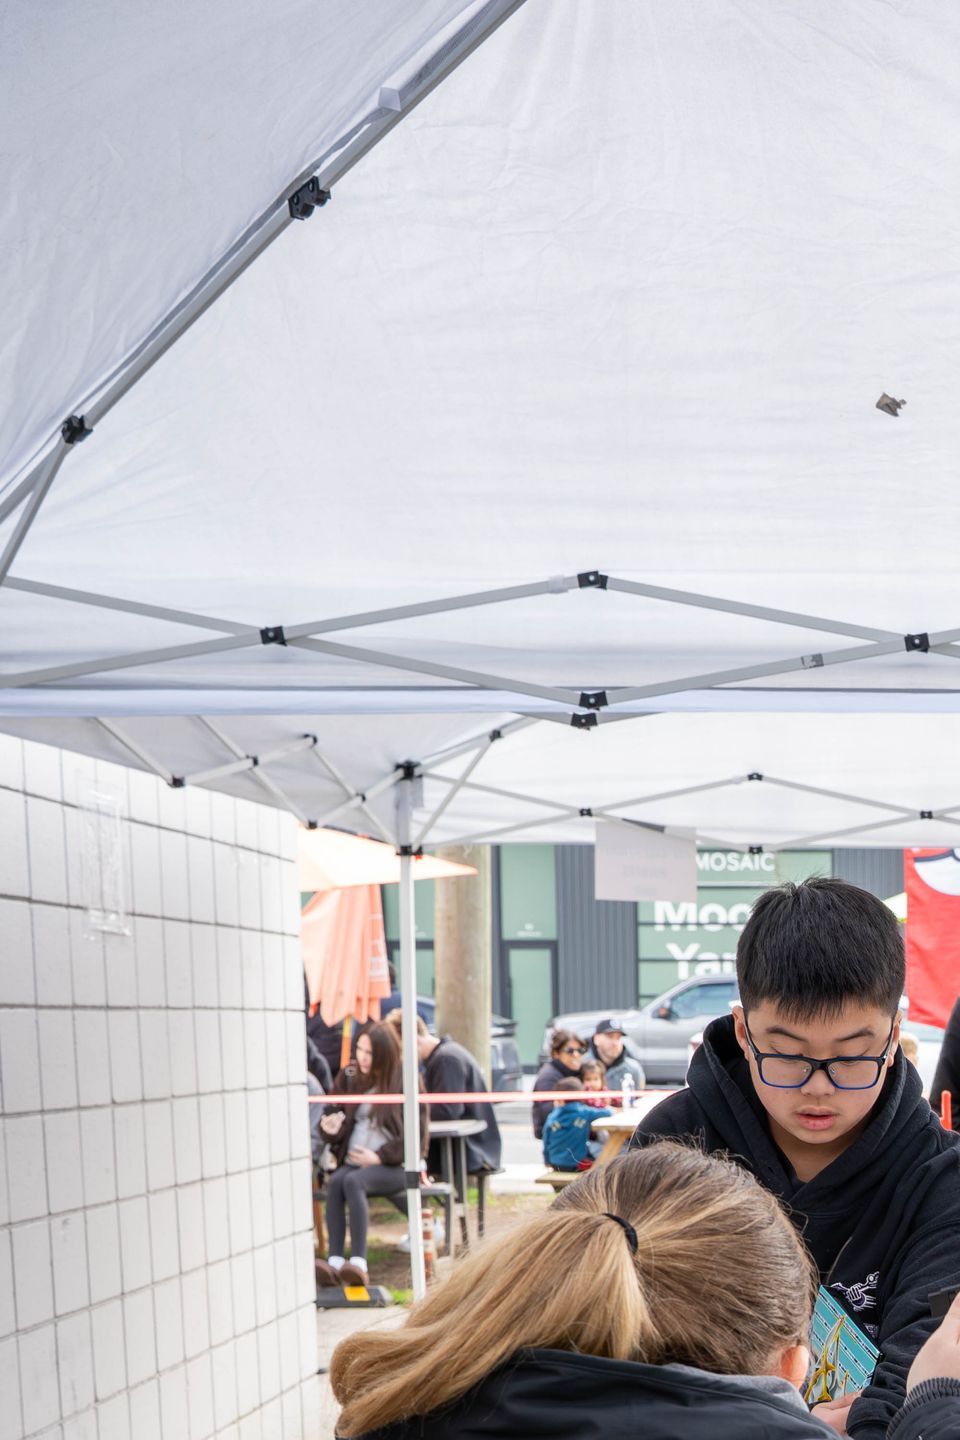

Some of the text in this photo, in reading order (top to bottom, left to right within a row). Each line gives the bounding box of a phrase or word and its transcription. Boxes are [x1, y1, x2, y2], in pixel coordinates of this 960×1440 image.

[696, 852, 776, 872] MOSAIC
[654, 901, 753, 932] Moo
[665, 942, 737, 980] Yar
